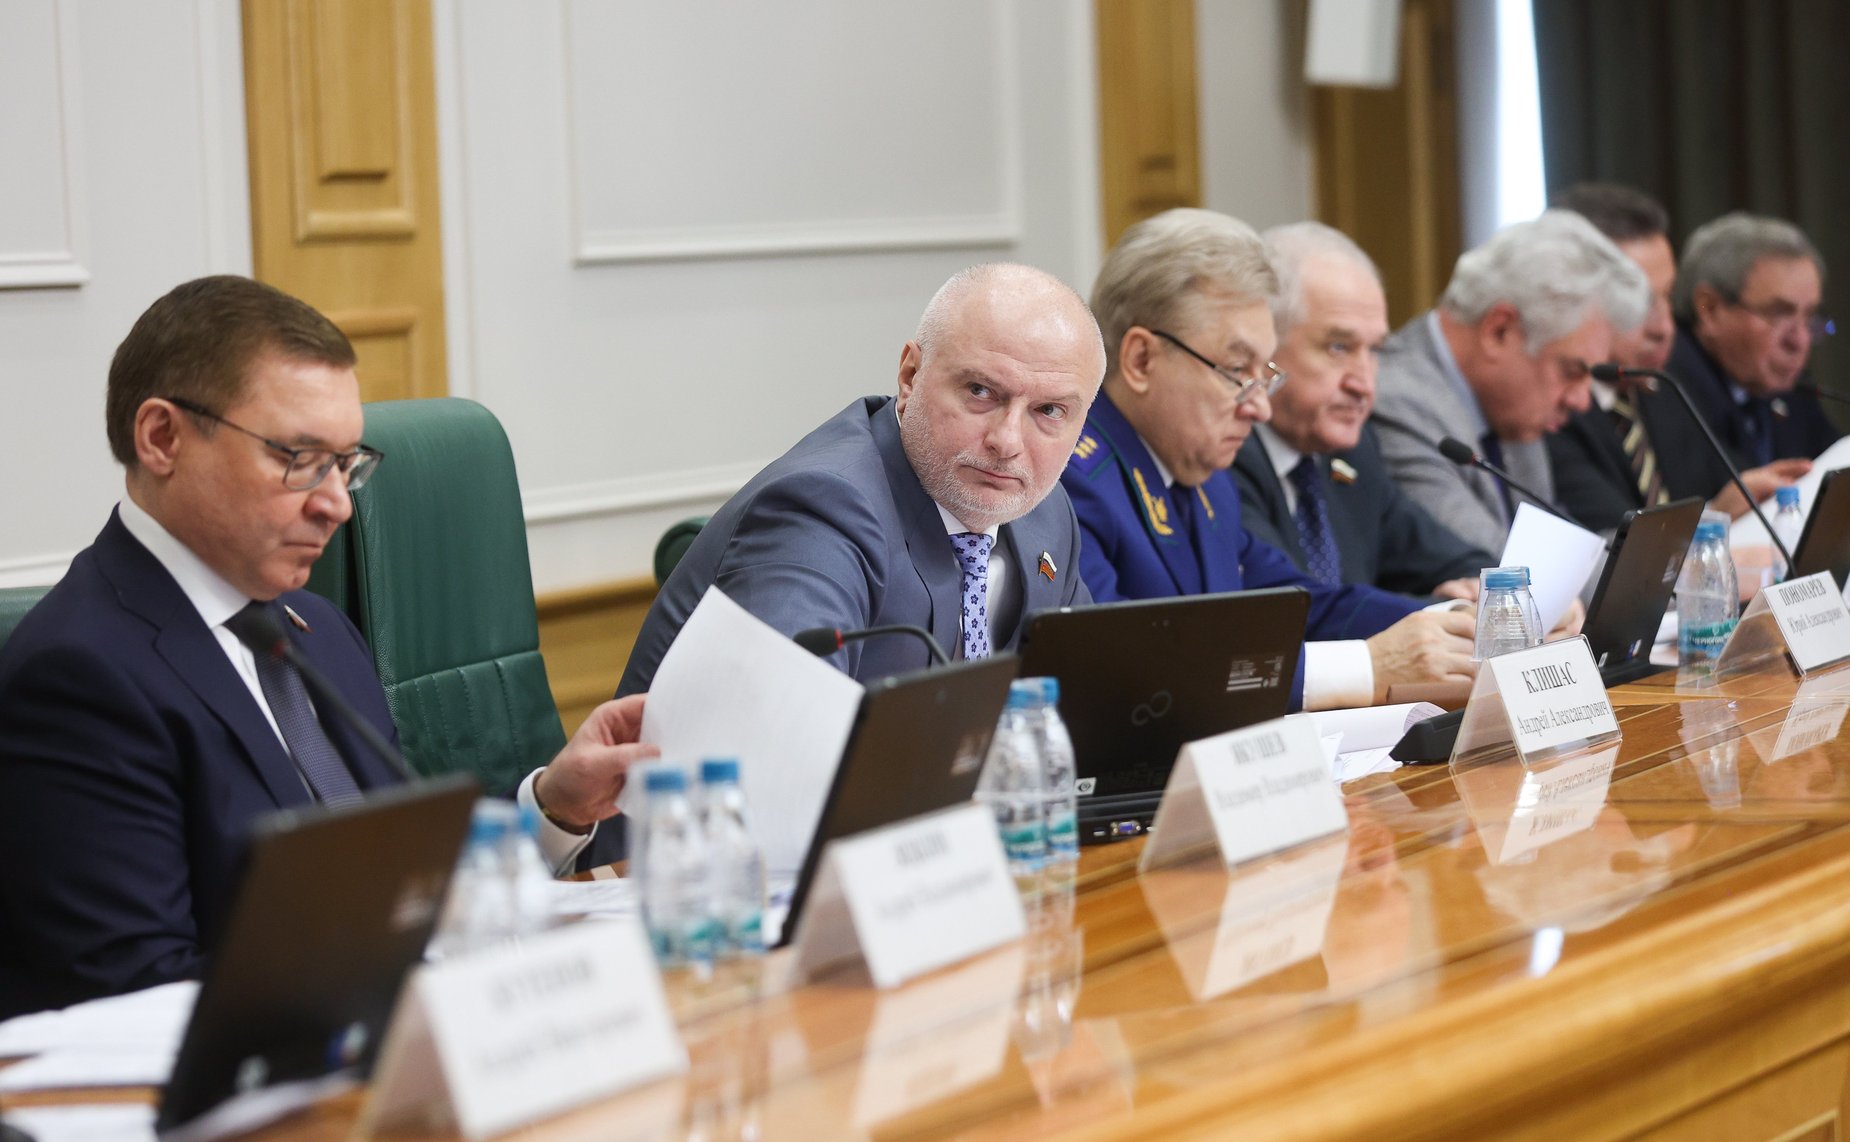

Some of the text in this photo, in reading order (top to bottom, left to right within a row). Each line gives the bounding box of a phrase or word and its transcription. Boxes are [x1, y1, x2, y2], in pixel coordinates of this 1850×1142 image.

[1778, 578, 1827, 607] ПОНОМАРЕВ
[1521, 661, 1577, 693] КЛИШАС
[1517, 701, 1610, 736] Андрей Александрович
